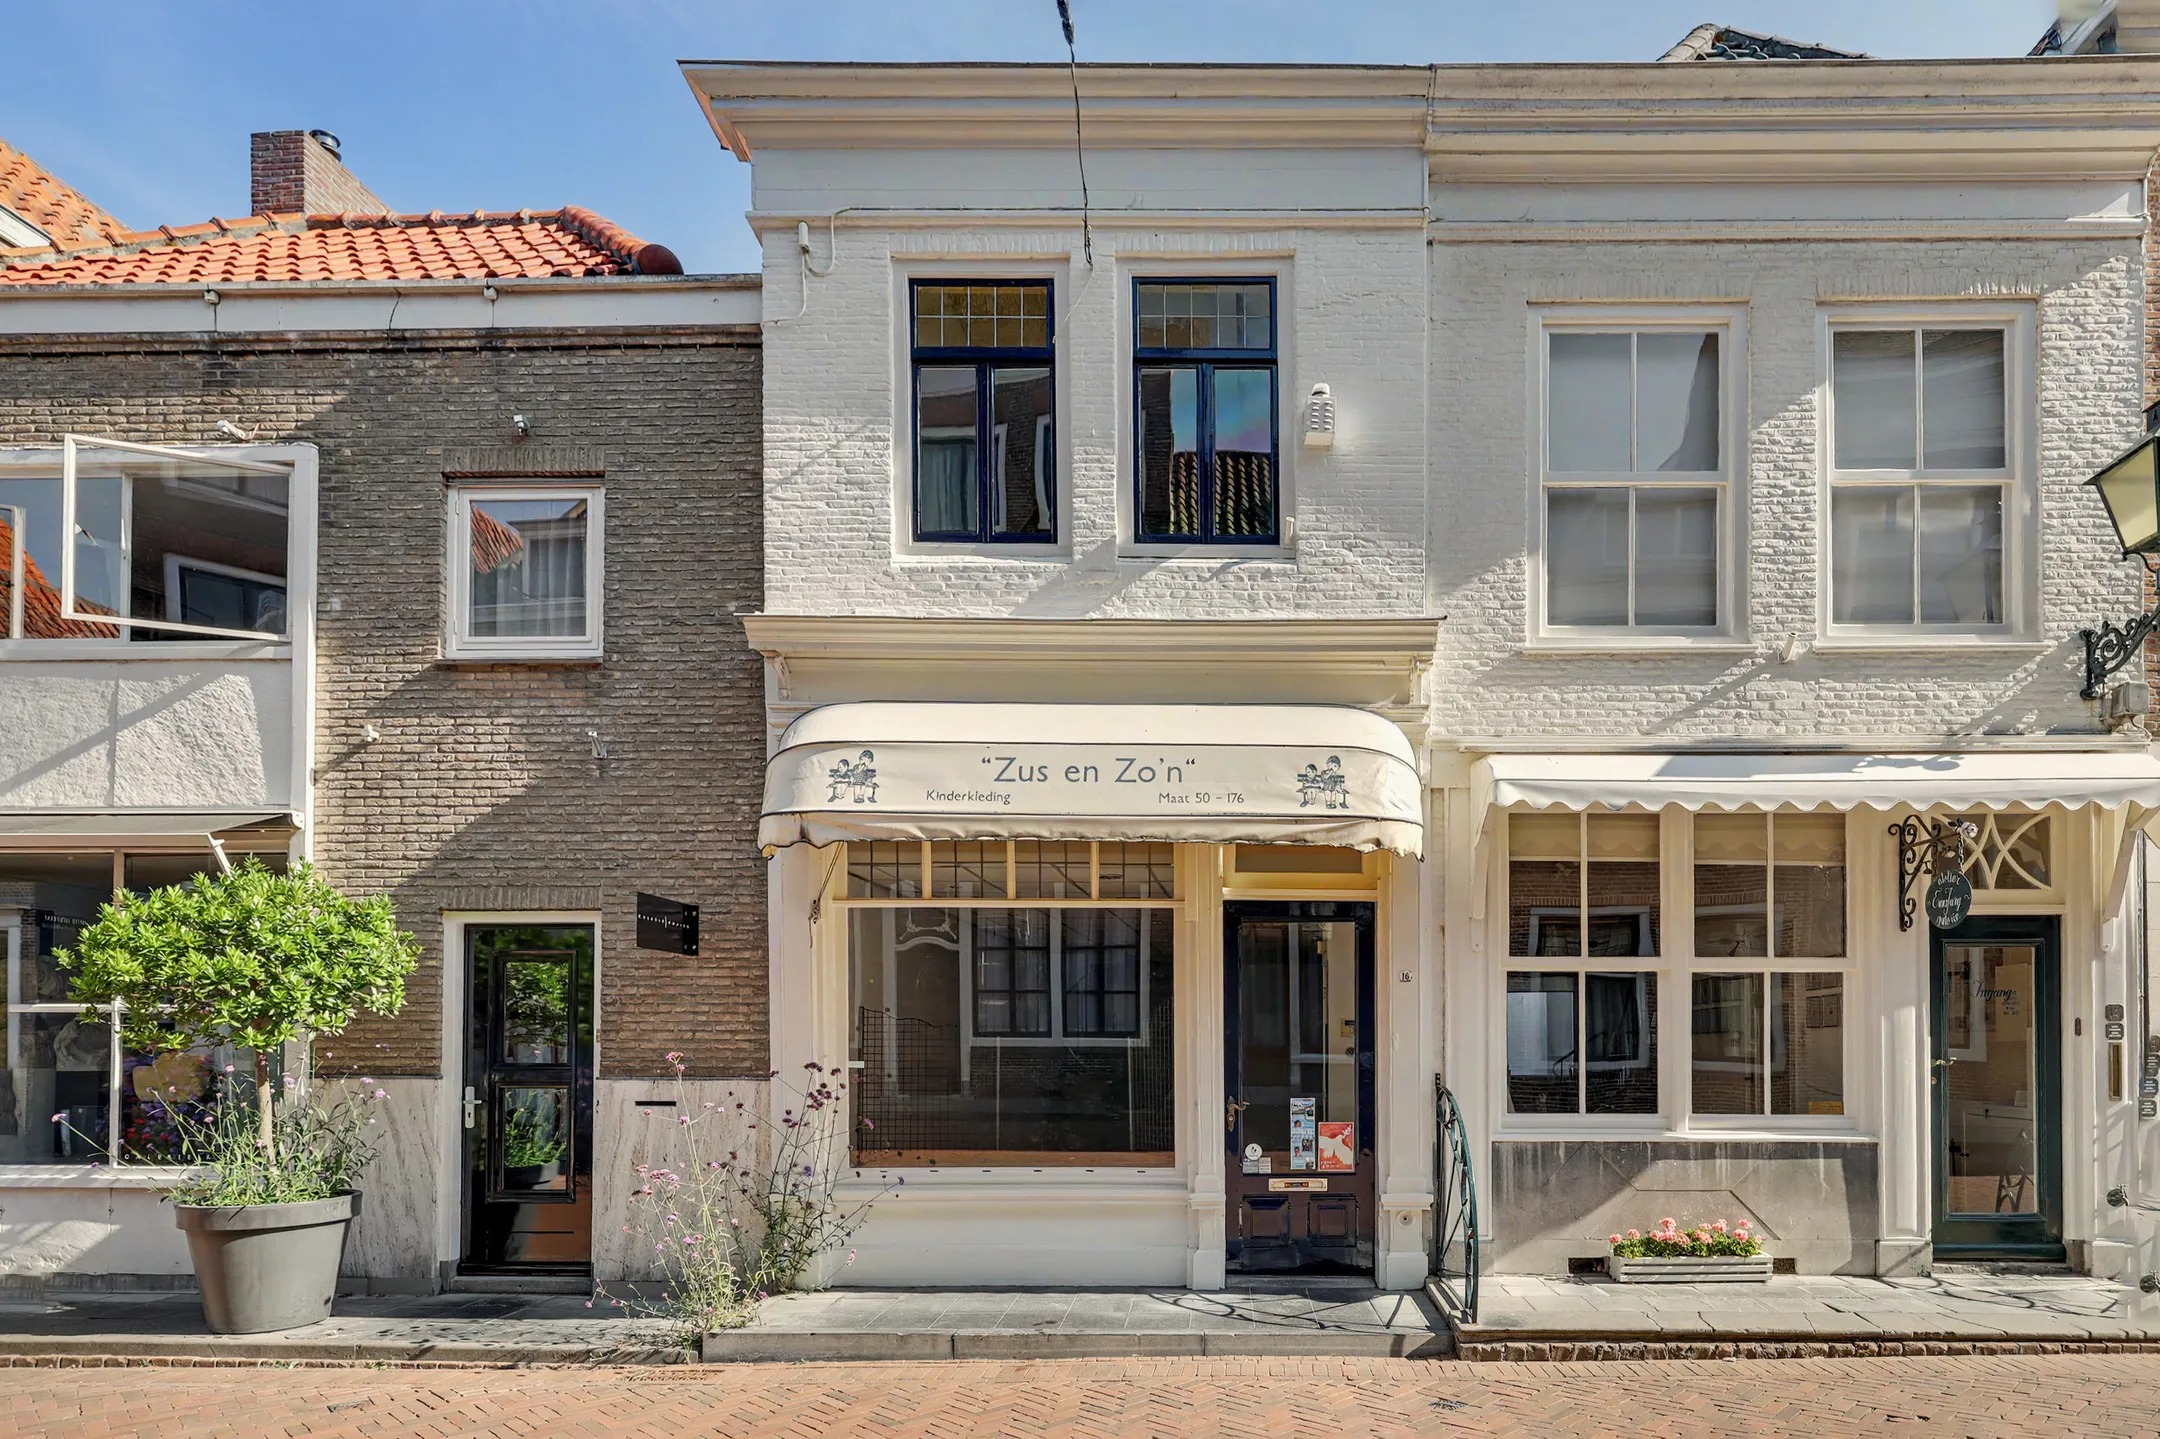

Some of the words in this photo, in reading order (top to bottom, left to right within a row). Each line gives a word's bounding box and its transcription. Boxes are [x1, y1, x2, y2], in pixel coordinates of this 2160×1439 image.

[1064, 764, 1099, 783] en
[925, 788, 1011, 806] Kinderkleding
[1158, 791, 1190, 804] Maat
[1195, 792, 1211, 804] 50
[1227, 792, 1245, 804] 176
[1970, 980, 2013, 1002] Ingang
